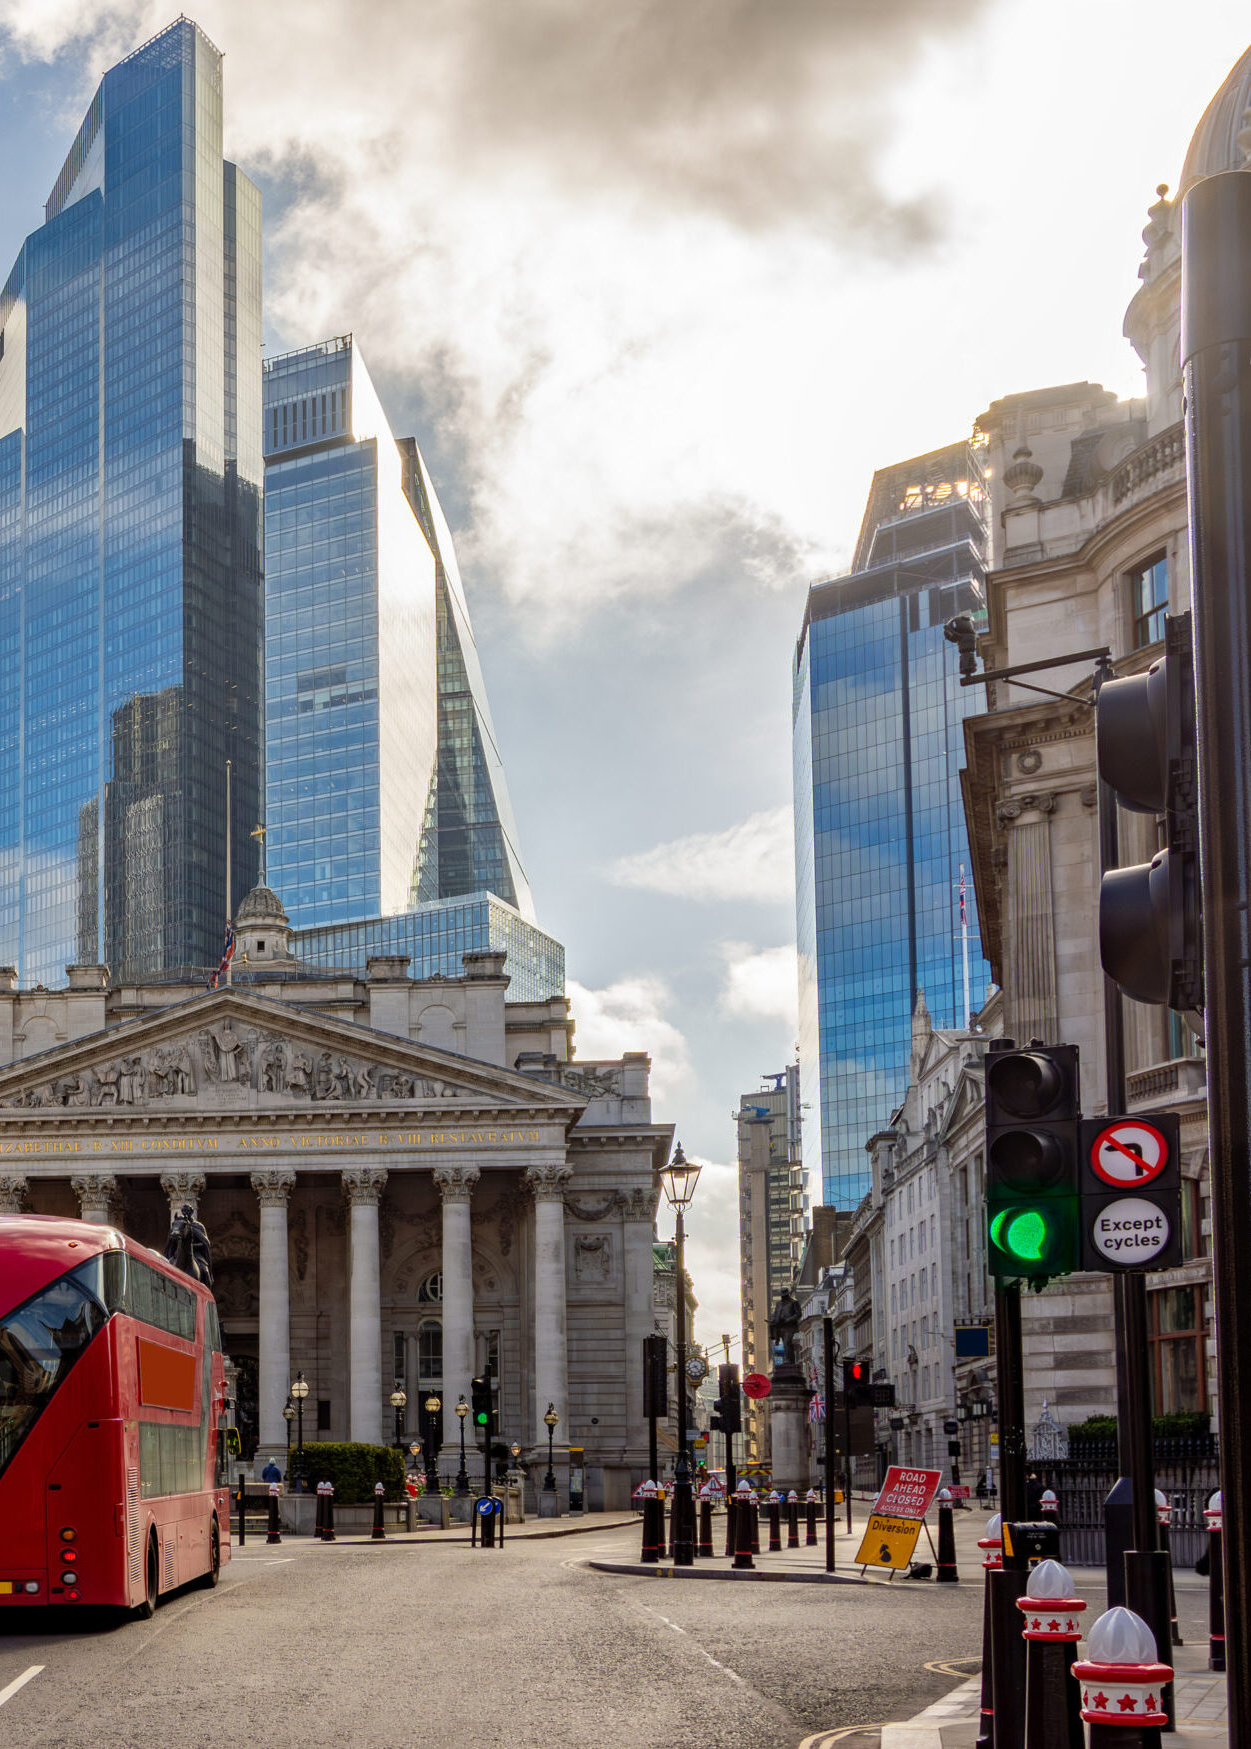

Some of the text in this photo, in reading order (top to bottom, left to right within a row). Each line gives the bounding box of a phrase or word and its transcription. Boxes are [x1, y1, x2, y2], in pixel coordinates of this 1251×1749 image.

[93, 1140, 103, 1151] R
[110, 1139, 134, 1152] XIII
[141, 1137, 218, 1151] CONDITVM
[237, 1136, 281, 1149] ANNO
[290, 1134, 370, 1147] VICTORIAE
[378, 1134, 389, 1146] R
[397, 1133, 421, 1145] VIII
[430, 1131, 541, 1145] RESTAVRATVM
[1101, 1216, 1163, 1232] Except
[1104, 1234, 1160, 1250] cycles
[899, 1472, 926, 1483] ROAD
[892, 1483, 926, 1495] AHEAD
[886, 1493, 924, 1506] CLOSED
[872, 1520, 916, 1535] Diversion
